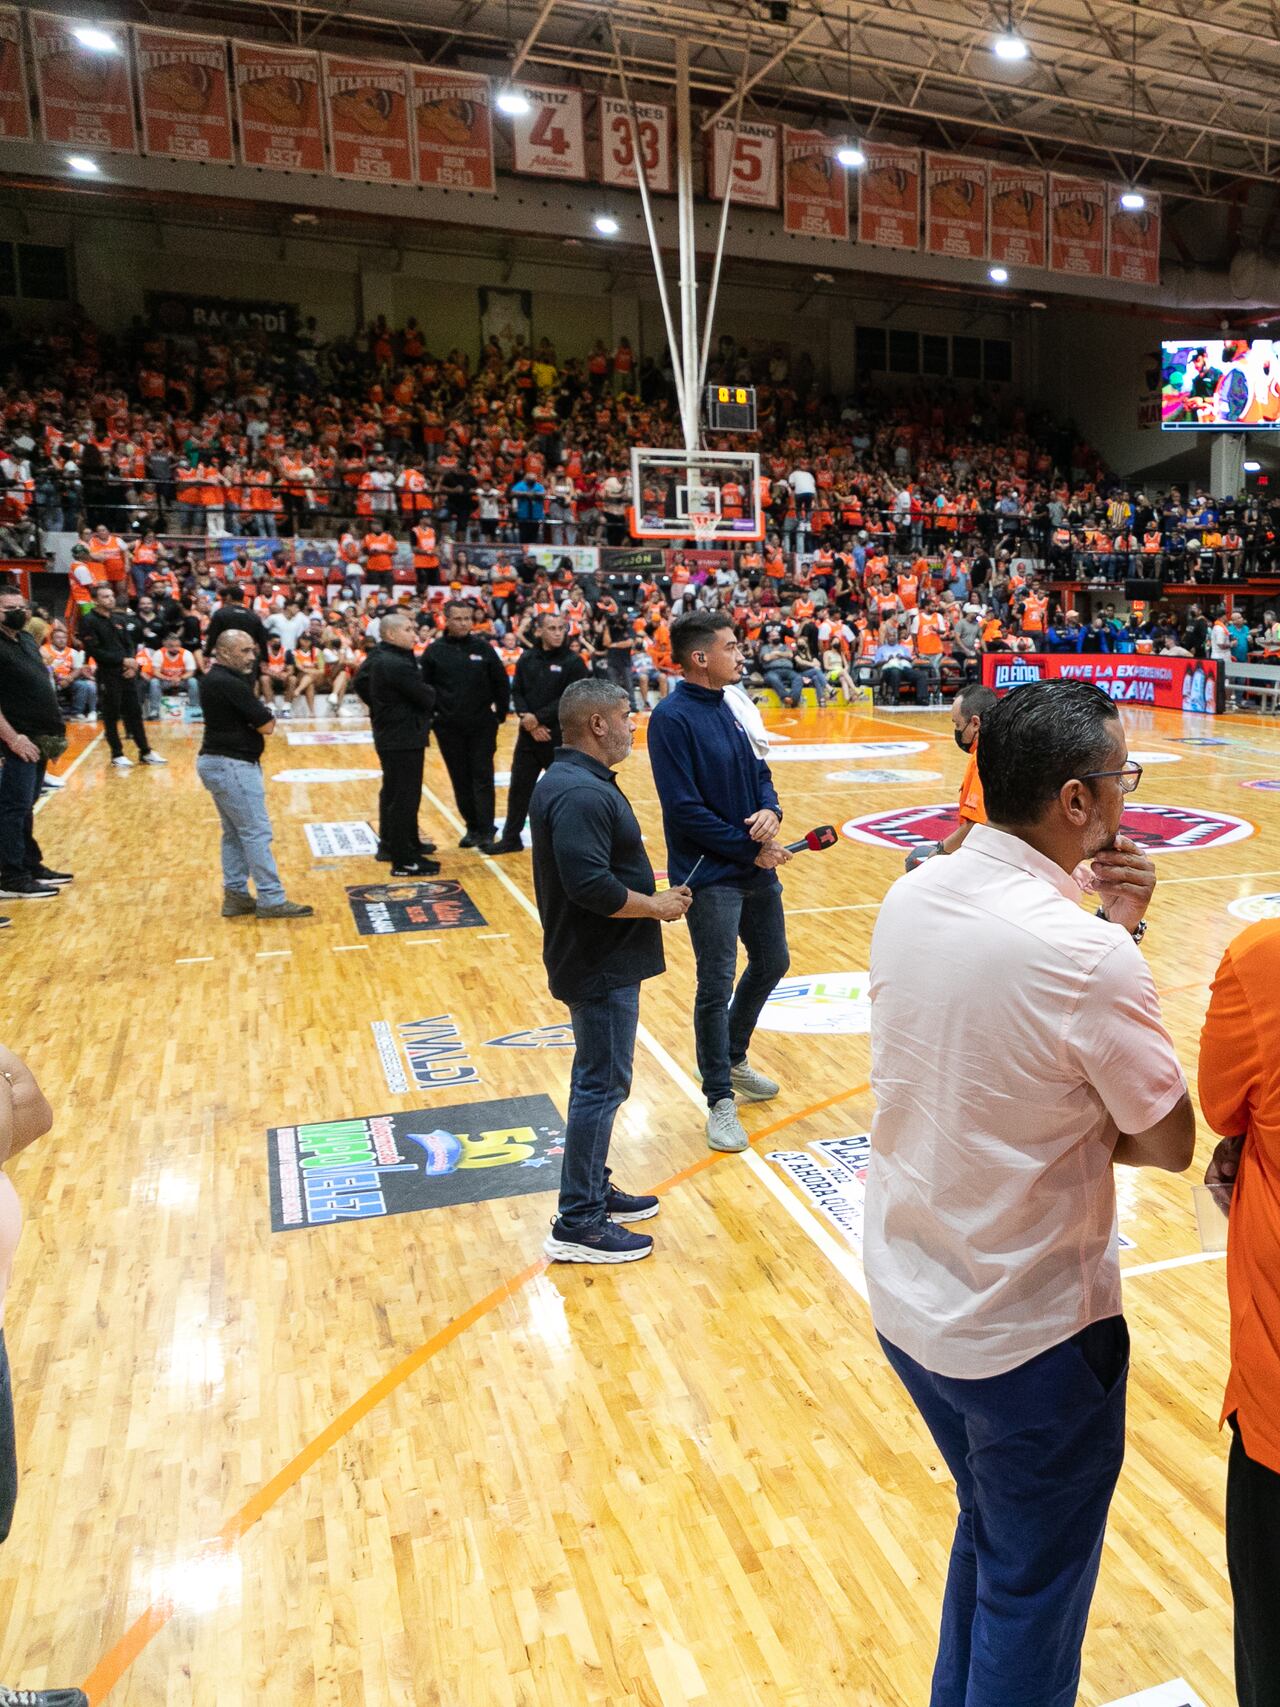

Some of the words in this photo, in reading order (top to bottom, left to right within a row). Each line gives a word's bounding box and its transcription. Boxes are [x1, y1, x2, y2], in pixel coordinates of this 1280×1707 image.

[529, 108, 570, 155] 4
[611, 116, 660, 170] 33
[732, 137, 762, 183] 5
[1060, 665, 1092, 678] VIVE
[1096, 665, 1113, 678] LA
[1116, 665, 1173, 680] EXPERIENCIA
[788, 1163, 838, 1198] AHORA
